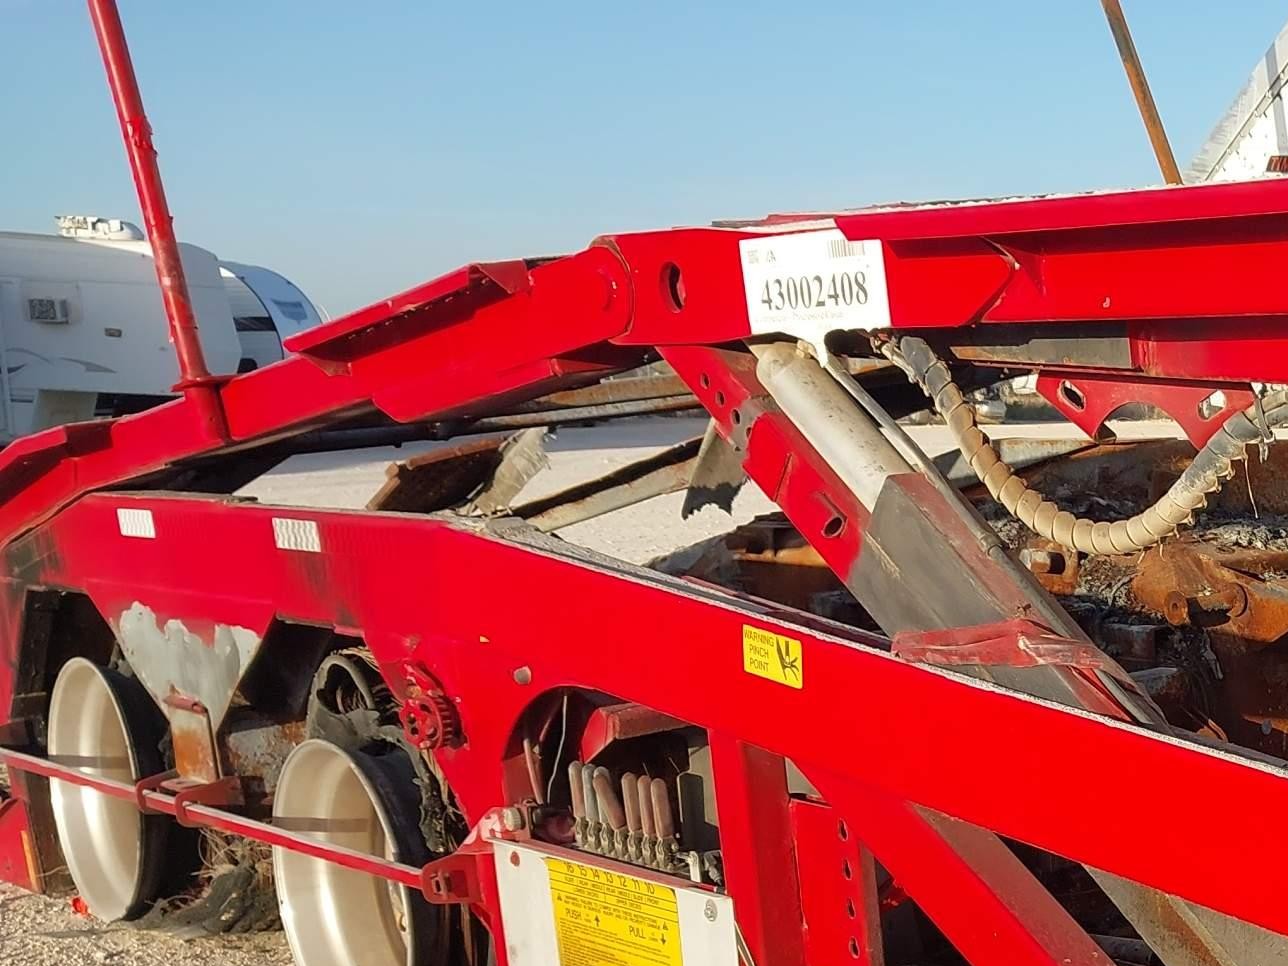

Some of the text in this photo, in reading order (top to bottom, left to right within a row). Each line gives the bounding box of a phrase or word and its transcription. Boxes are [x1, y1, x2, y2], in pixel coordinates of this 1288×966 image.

[761, 271, 869, 311] 43002408
[745, 629, 774, 647] WARNING
[749, 643, 769, 659] PINCH
[750, 657, 769, 672] POINT
[618, 873, 628, 887] 12
[565, 908, 582, 920] PUSH
[629, 925, 646, 939] PULL
